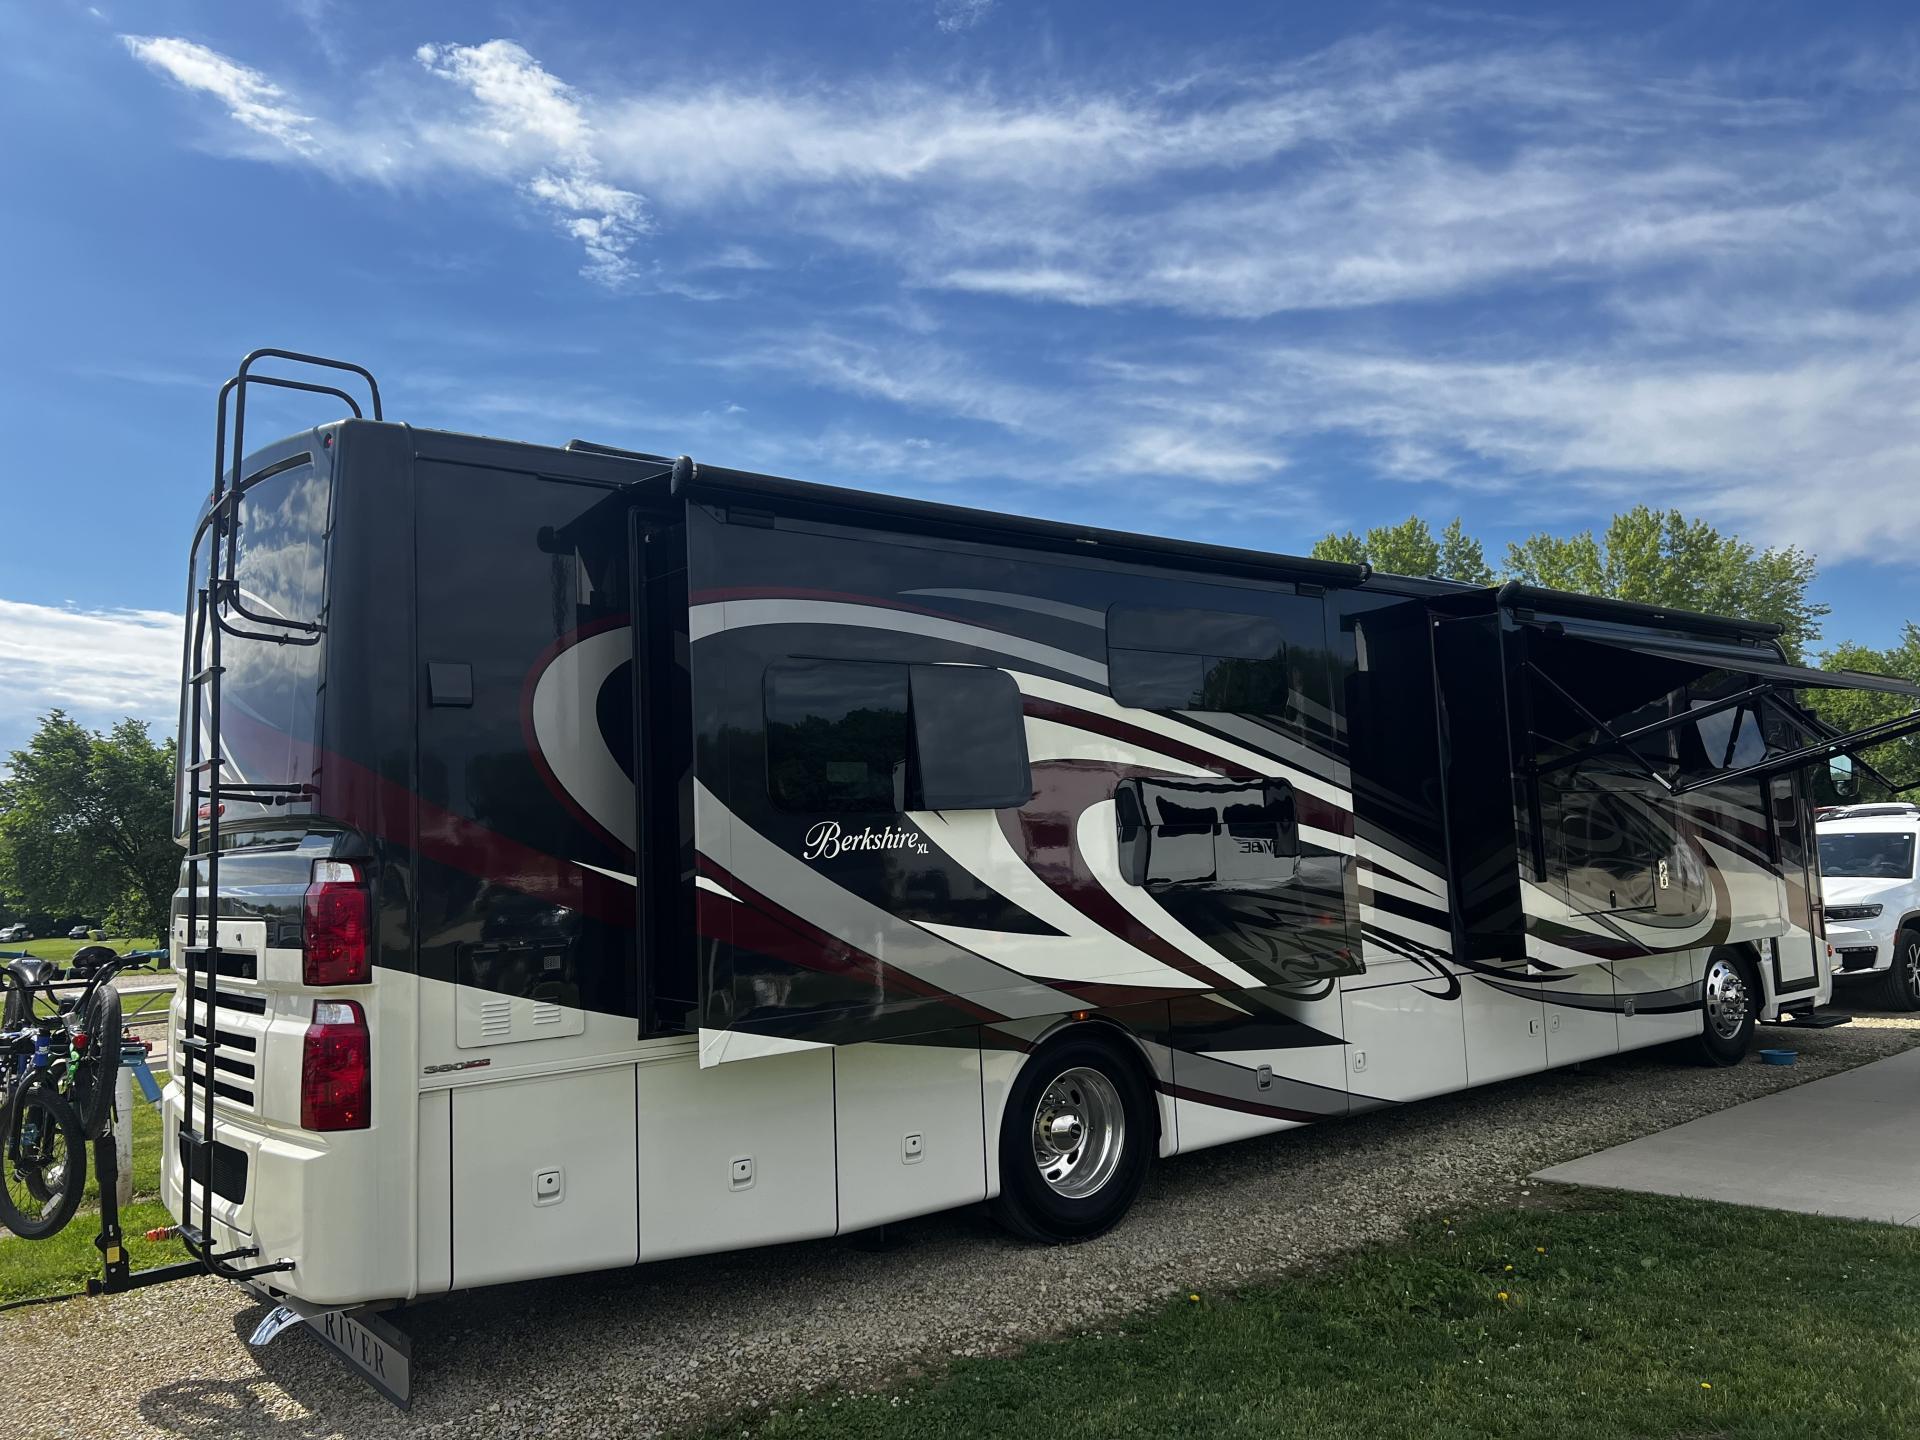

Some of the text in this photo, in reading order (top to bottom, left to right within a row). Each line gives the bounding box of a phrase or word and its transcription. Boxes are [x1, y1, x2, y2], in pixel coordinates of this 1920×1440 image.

[803, 820, 929, 860] Berkshire XL
[324, 1311, 386, 1380] RIVER
